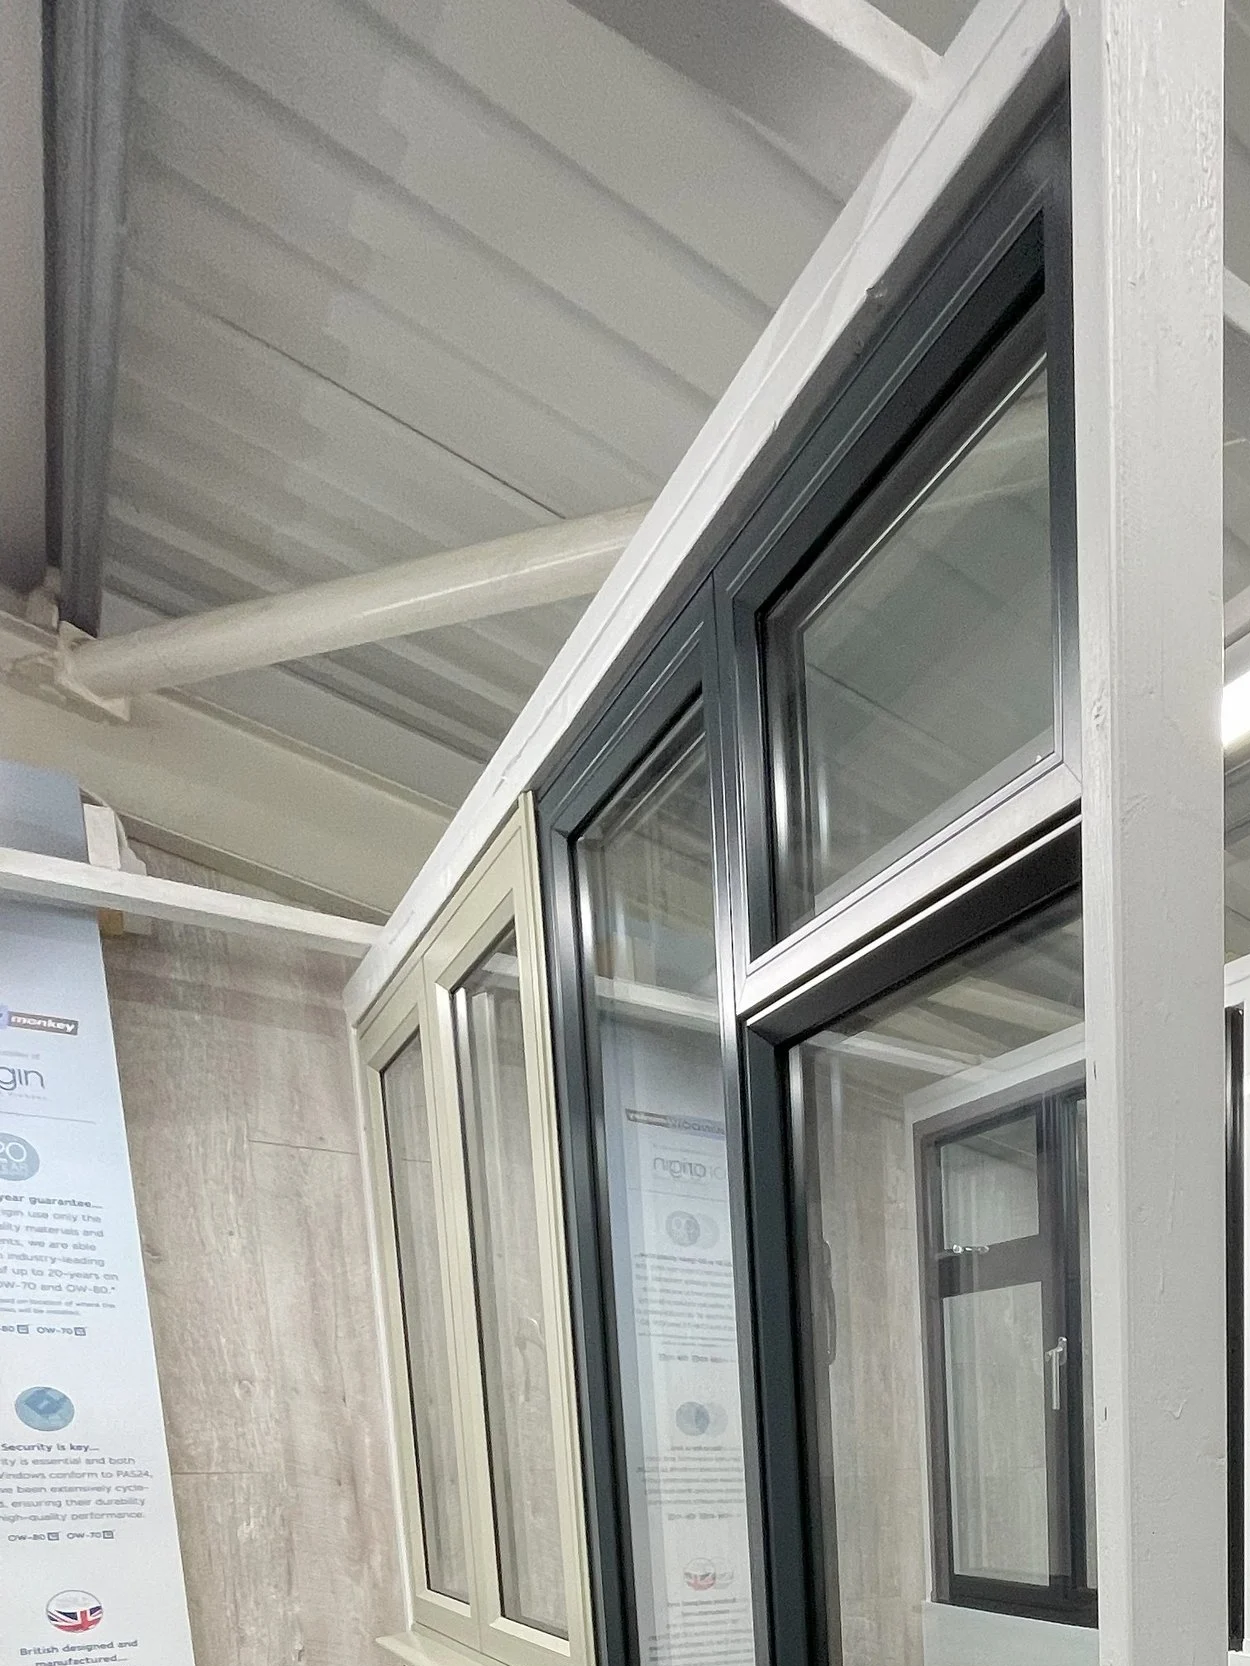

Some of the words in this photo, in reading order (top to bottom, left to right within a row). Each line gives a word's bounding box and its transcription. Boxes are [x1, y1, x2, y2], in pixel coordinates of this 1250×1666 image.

[11, 1015, 75, 1033] monkey
[28, 1210, 48, 1219] use
[53, 1212, 78, 1222] only
[82, 1214, 102, 1223] the
[25, 1225, 79, 1236] materials
[83, 1229, 104, 1238] and
[28, 1240, 45, 1248] we
[72, 1242, 96, 1251] able
[12, 1269, 28, 1277] up
[31, 1268, 44, 1276] to
[48, 1268, 100, 1280] 20-years
[103, 1273, 119, 1281] on
[40, 1283, 62, 1292] and
[36, 1326, 73, 1335] OW-70
[1, 1442, 52, 1453] Security
[56, 1443, 66, 1451] is
[20, 1457, 29, 1466] is
[31, 1456, 81, 1466] essential
[85, 1456, 105, 1465] and
[108, 1456, 136, 1465] both
[49, 1471, 98, 1479] conform
[101, 1470, 113, 1479] to
[17, 1485, 47, 1494] been
[50, 1484, 112, 1495] extensively
[11, 1498, 62, 1509] ensuring
[65, 1497, 91, 1507] their
[95, 1496, 145, 1507] durability
[8, 1534, 45, 1542] OW-80
[66, 1532, 101, 1540] OW-70
[20, 1645, 59, 1656] British
[62, 1641, 114, 1652] designed
[118, 1640, 138, 1649] and
